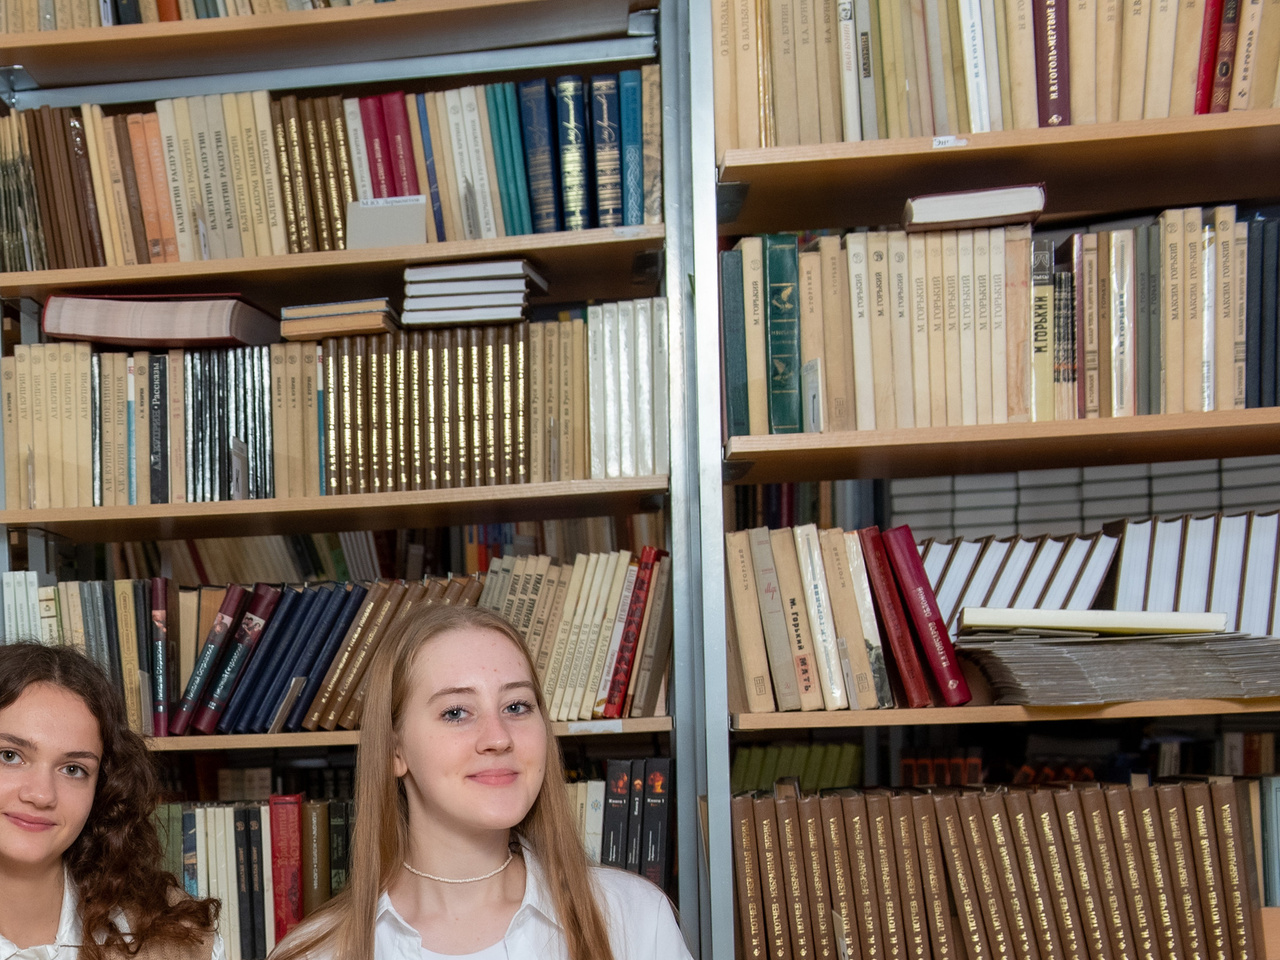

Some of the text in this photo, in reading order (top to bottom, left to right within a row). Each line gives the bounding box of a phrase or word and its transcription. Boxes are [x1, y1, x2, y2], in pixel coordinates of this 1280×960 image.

[740, 0, 750, 41] БАЛЬЗА
[166, 135, 187, 233] ВАЛЕНТИН РАСПУТИН
[198, 131, 218, 231] ВАЛЕНТИН РАСПУТИН
[214, 129, 234, 230] ВАЛЕНТИН РАСПУТИН
[230, 135, 250, 233] ВАЛЕНТИН РАСПУТИН
[244, 127, 264, 225] ВАЛЕНТИН РАСПУТИН
[259, 129, 279, 228] ВАЛЕНТИН РАСПУТИН
[751, 280, 761, 316] ГОРЬКИЙ
[854, 273, 864, 309] ГОРЬКИЙ
[875, 272, 884, 307] ГОРЬКИЙ
[897, 272, 905, 309] ГОРЬКИЙ
[916, 276, 925, 321] ГОРЬКИЙ
[932, 275, 941, 320] ГОРЬКИЙ
[948, 274, 957, 318] ГОРЬКИЙ
[962, 274, 971, 318] ГОРЬКИЙ
[978, 274, 987, 318] ГОРЬКИЙ
[993, 273, 1003, 317] ГОРЬКИЙ
[1169, 242, 1180, 320] МАКСИМ ГОРЬКИЙ
[1189, 241, 1199, 320] МАКСИМ ГОРЬКИЙ
[1221, 240, 1231, 319] МАКСИМ ГОРЬКИЙ
[103, 373, 112, 424] ПОЕДИНОК
[116, 376, 125, 426] ПОЕДИНОК
[151, 362, 161, 405] Рассказы
[789, 597, 804, 651] М. Горький
[799, 657, 810, 693] МАТЬ
